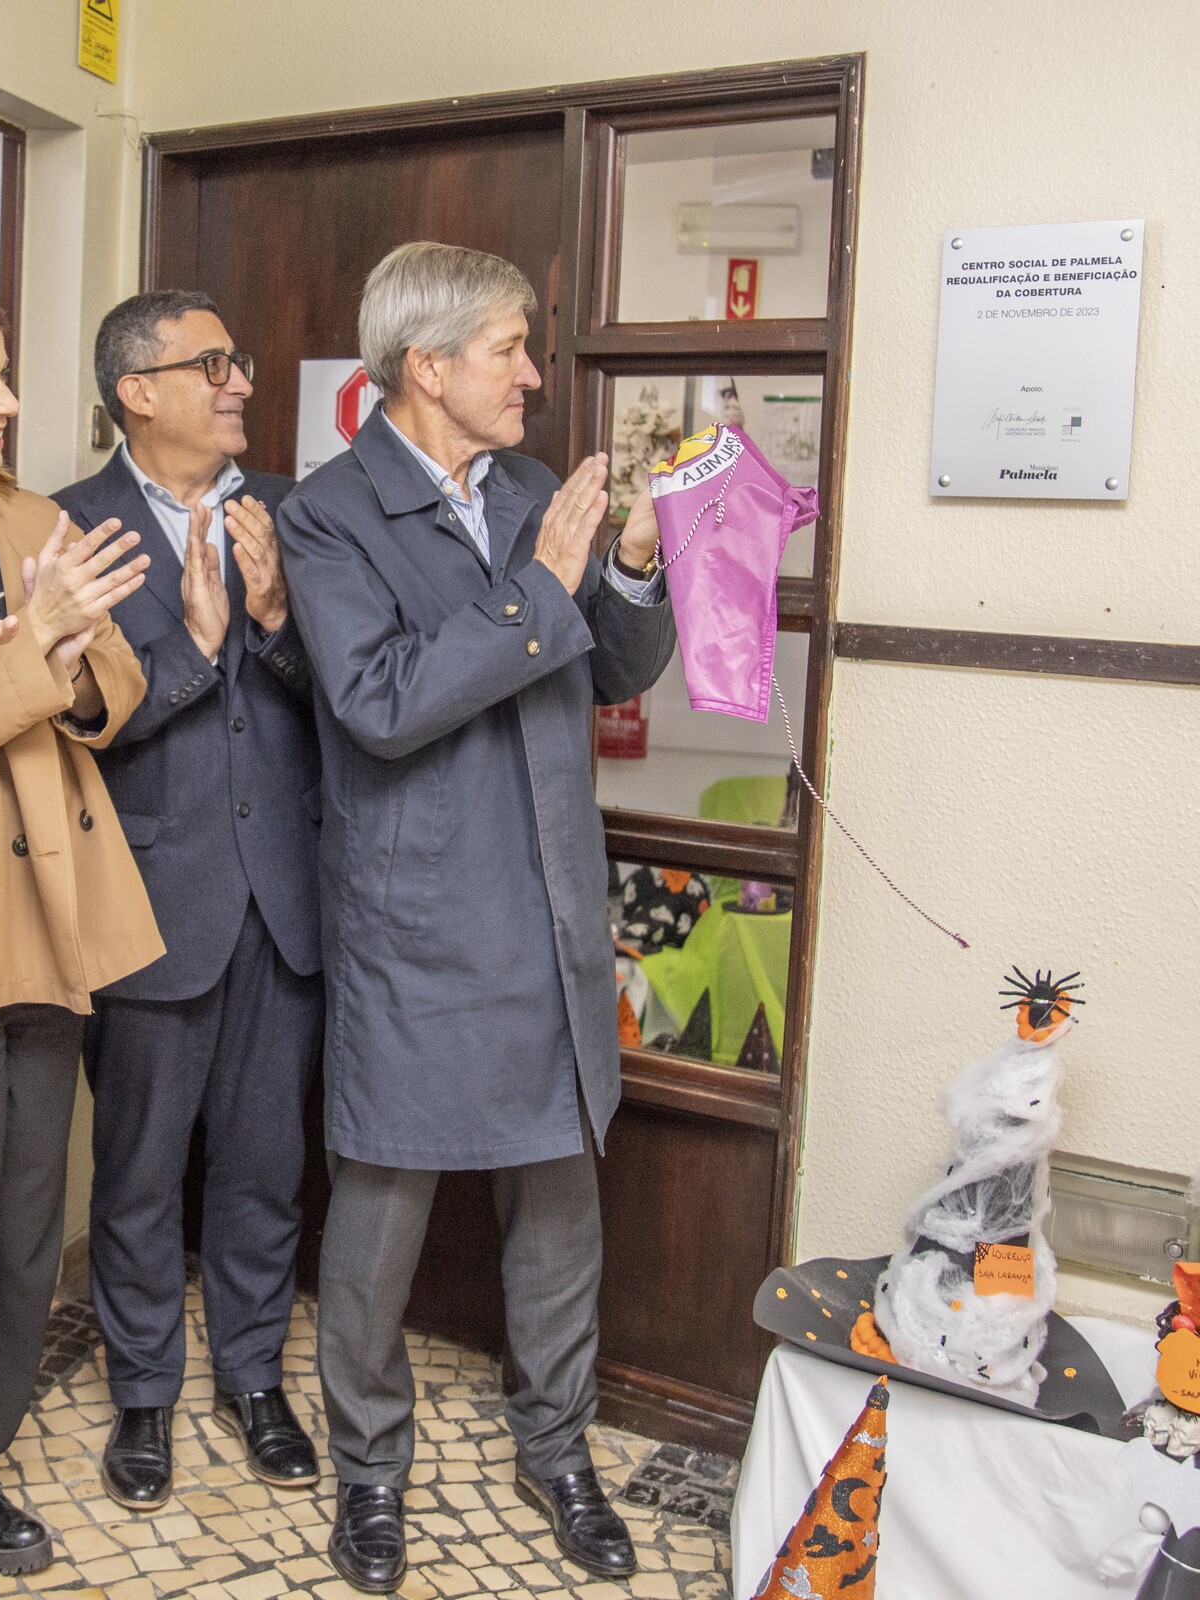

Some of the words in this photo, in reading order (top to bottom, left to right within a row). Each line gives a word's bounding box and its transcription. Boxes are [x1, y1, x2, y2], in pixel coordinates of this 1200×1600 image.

[961, 261, 1005, 271] CENTRO
[1008, 259, 1048, 269] SOCIAL
[1051, 258, 1067, 267] DE
[1070, 256, 1123, 266] PALMELA
[946, 272, 1040, 285] REQUALIFICAÇÃO
[1043, 273, 1050, 282] E
[1054, 268, 1138, 282] BENEFICIAÇÃO
[996, 289, 1011, 298] DA
[1014, 287, 1082, 298] COBERTURA
[977, 310, 983, 319] 2
[985, 309, 999, 319] DE
[1001, 308, 1058, 318] NOVEMBRO
[1060, 307, 1074, 317] DE
[1076, 307, 1100, 317] 2023
[1020, 385, 1044, 393] Apoio:
[999, 468, 1058, 480] Palmela
[1029, 464, 1059, 472] Município
